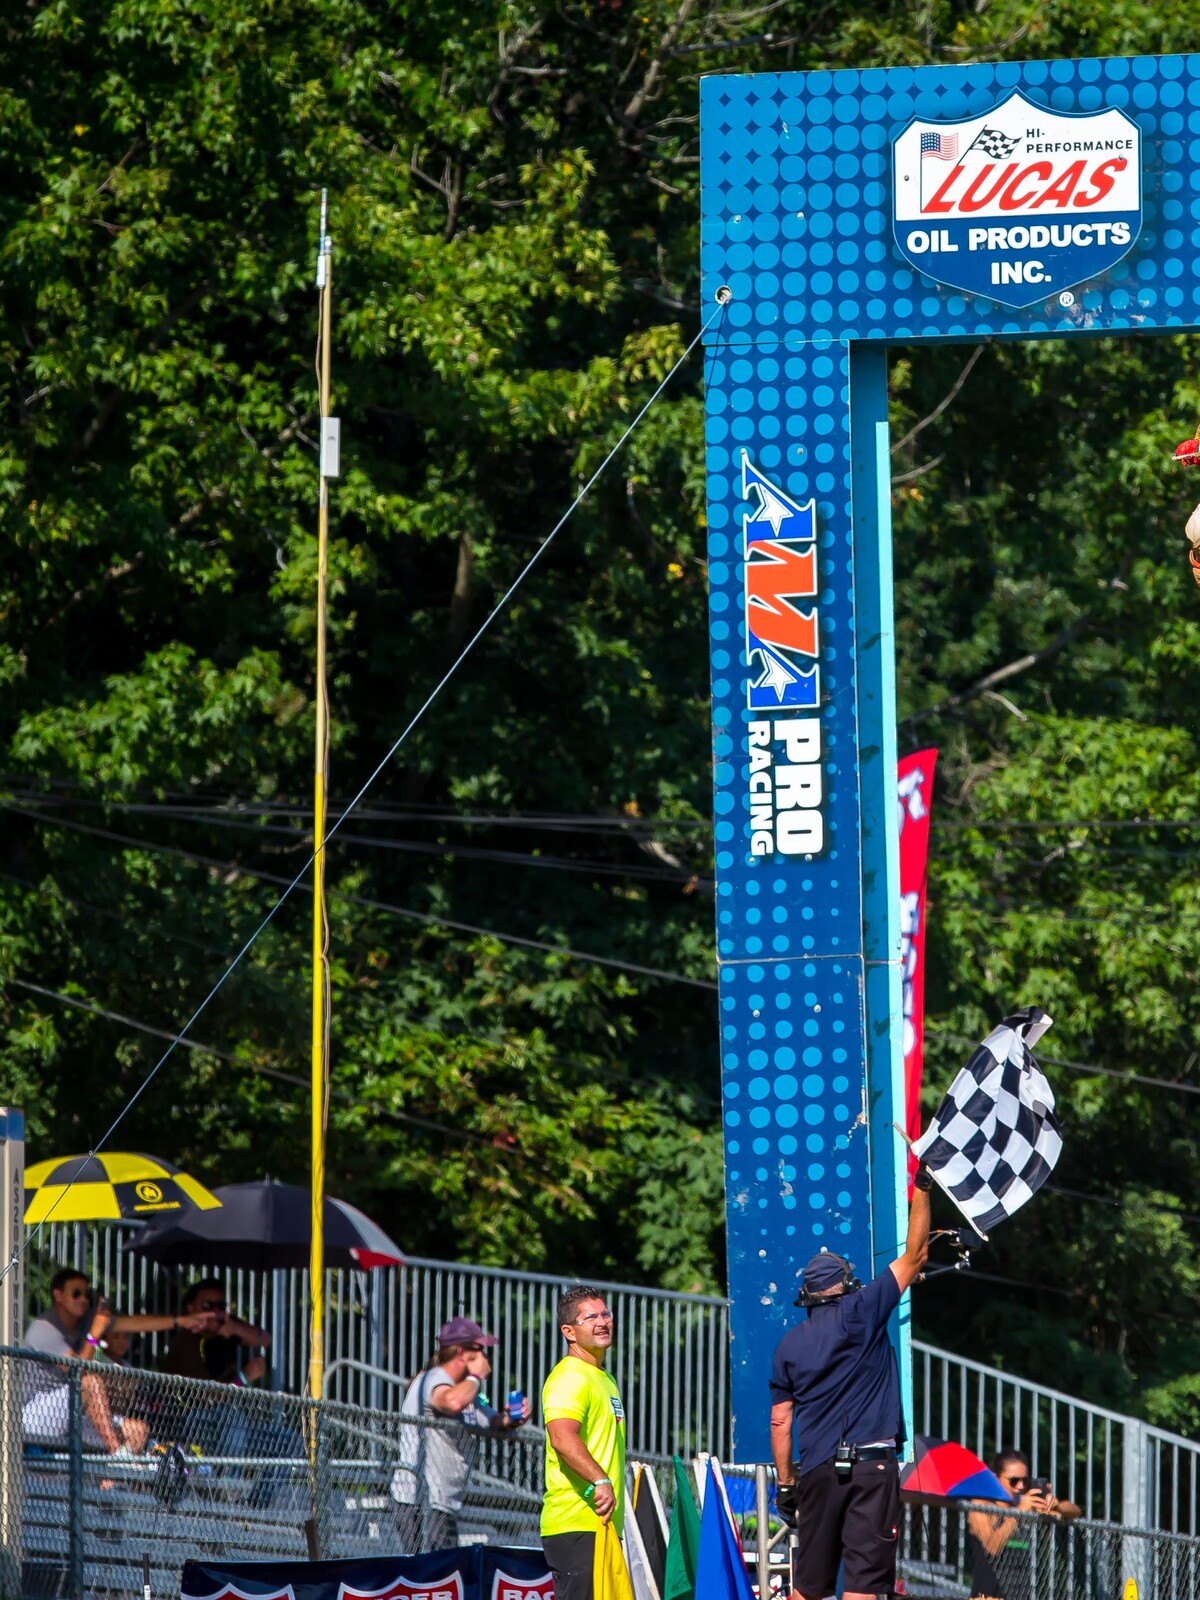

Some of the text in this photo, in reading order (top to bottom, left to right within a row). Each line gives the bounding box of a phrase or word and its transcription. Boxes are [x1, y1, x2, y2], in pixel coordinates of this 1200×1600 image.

[1026, 128, 1046, 139] HI-
[1026, 140, 1133, 153] PERFORMANCE
[920, 158, 1128, 213] LUCAS
[907, 222, 1131, 254] OIL PRODUCTS
[991, 261, 1052, 284] INC.
[748, 720, 774, 857] RACING
[773, 717, 824, 856] PRO
